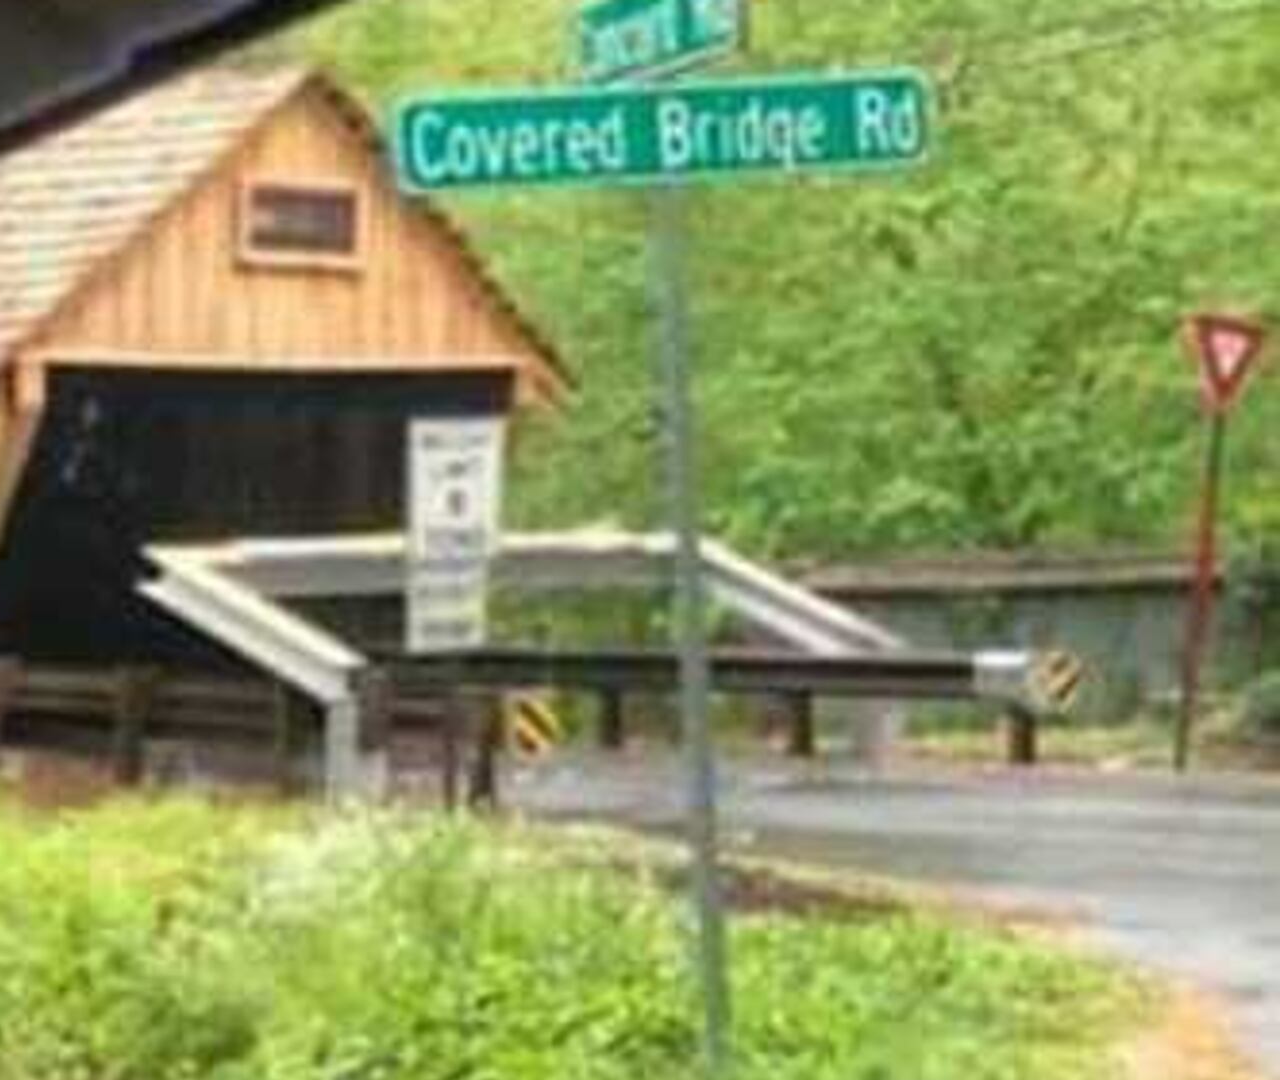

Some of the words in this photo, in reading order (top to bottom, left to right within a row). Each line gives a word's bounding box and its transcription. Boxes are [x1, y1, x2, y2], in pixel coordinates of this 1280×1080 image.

[411, 106, 624, 180] Covered
[656, 98, 826, 170] Bridge
[855, 87, 920, 153] Rd
